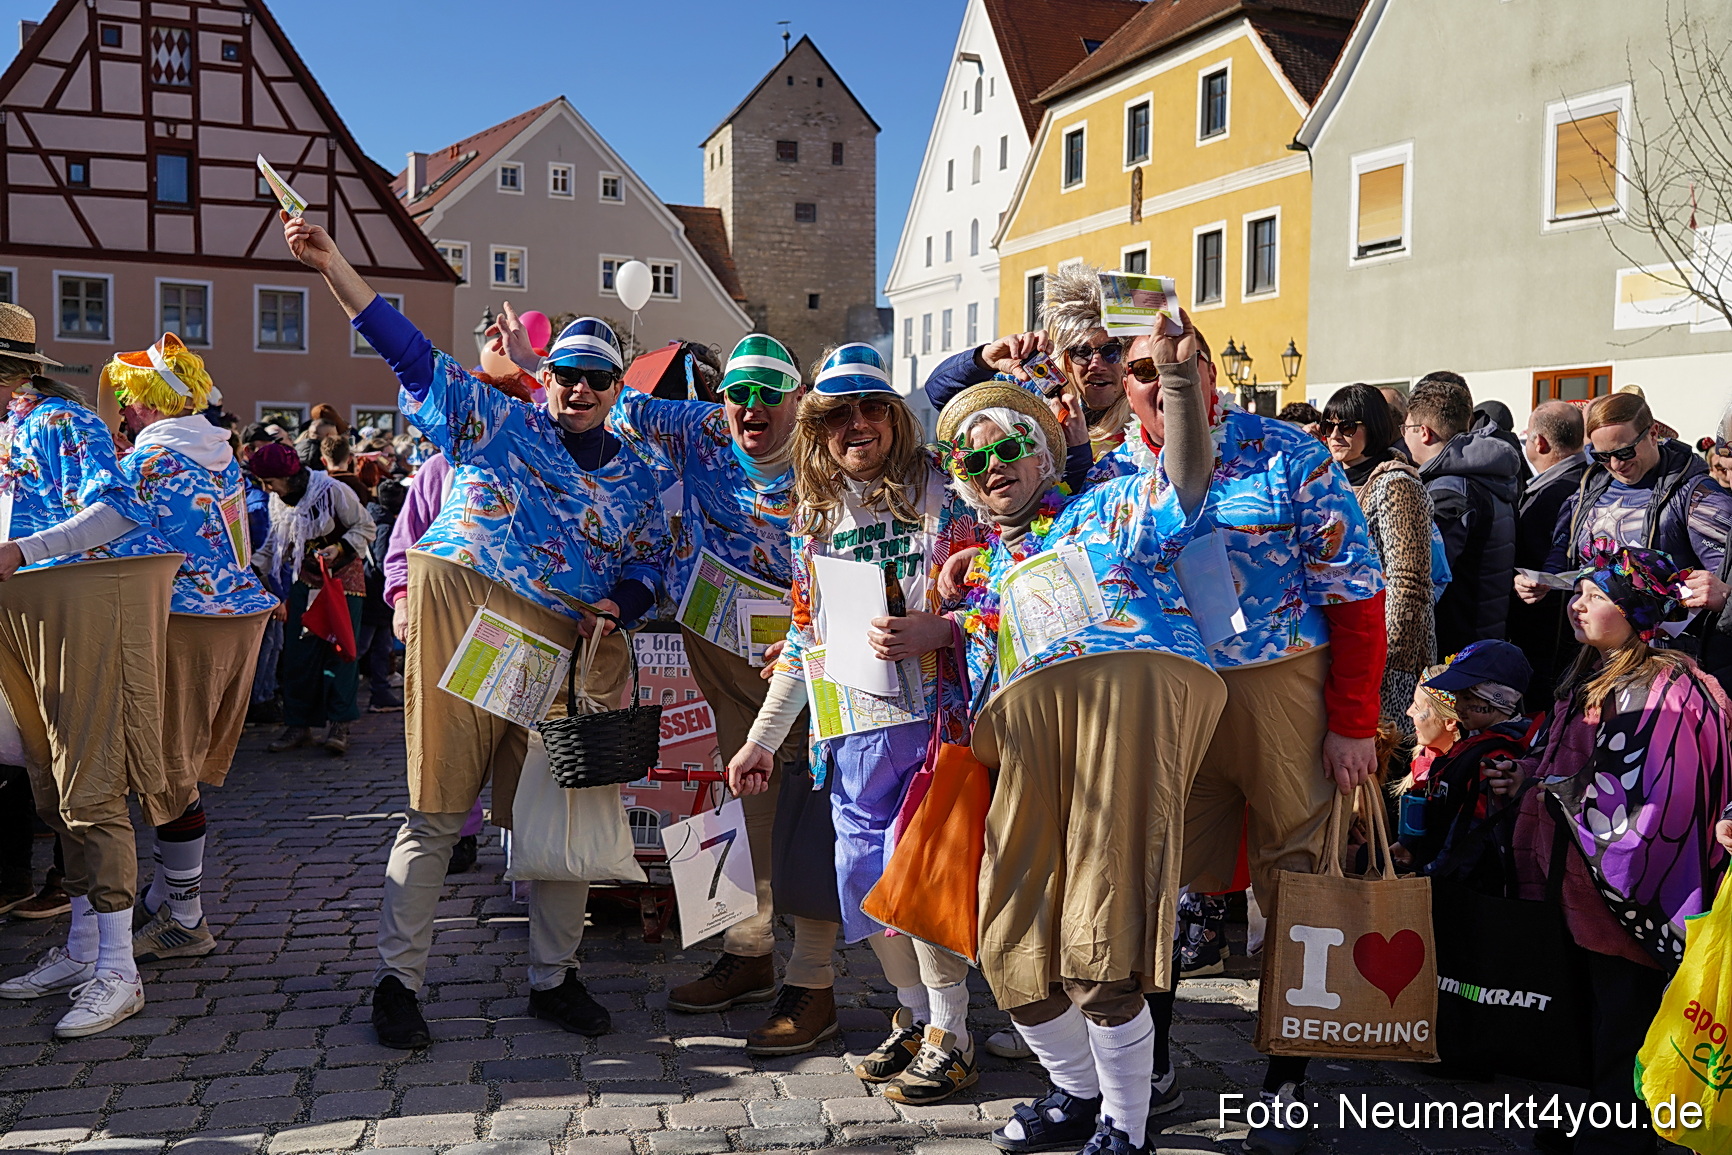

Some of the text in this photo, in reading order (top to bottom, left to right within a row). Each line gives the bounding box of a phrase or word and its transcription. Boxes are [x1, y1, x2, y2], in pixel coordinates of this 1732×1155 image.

[833, 522, 886, 550] WHICH
[853, 536, 911, 562] TO THE
[659, 705, 712, 740] SSEN
[700, 827, 738, 901] 7
[1285, 924, 1345, 1010] I
[1477, 987, 1552, 1011] KRAFT
[1281, 1016, 1430, 1043] BERCHING
